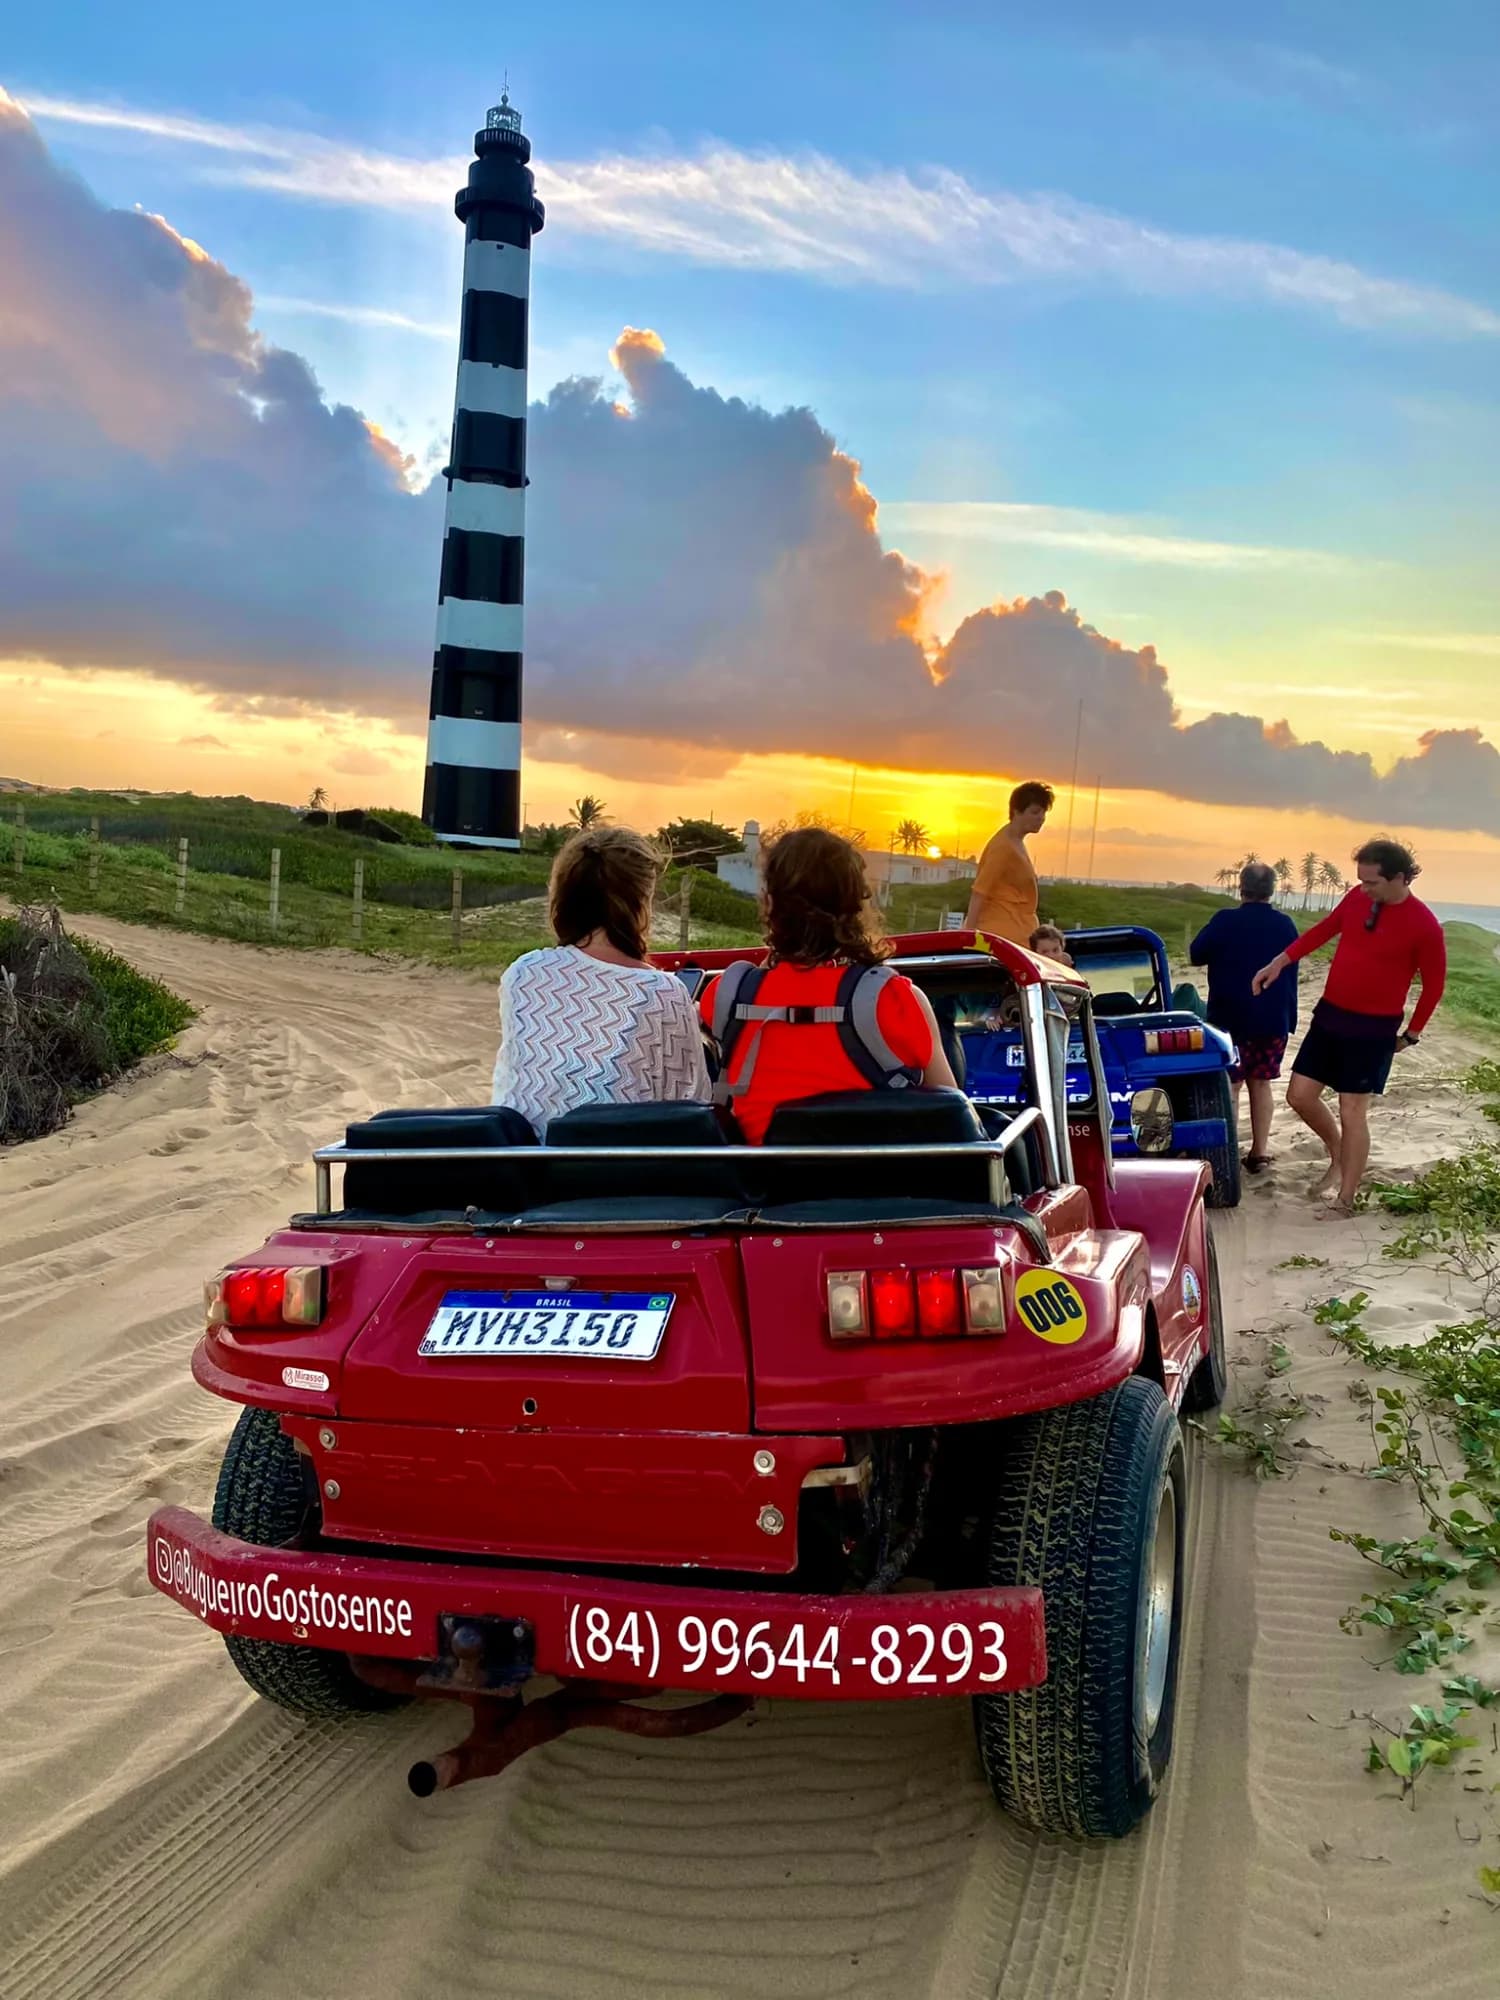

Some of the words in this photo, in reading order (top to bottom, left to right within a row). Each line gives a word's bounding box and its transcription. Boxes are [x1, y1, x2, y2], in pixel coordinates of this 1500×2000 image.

[535, 1298, 572, 1307] BRASIL
[1019, 1281, 1083, 1333] 006
[422, 1340, 437, 1352] BR
[172, 1547, 413, 1637] @BugueiroGostosense
[569, 1603, 661, 1679] (84)
